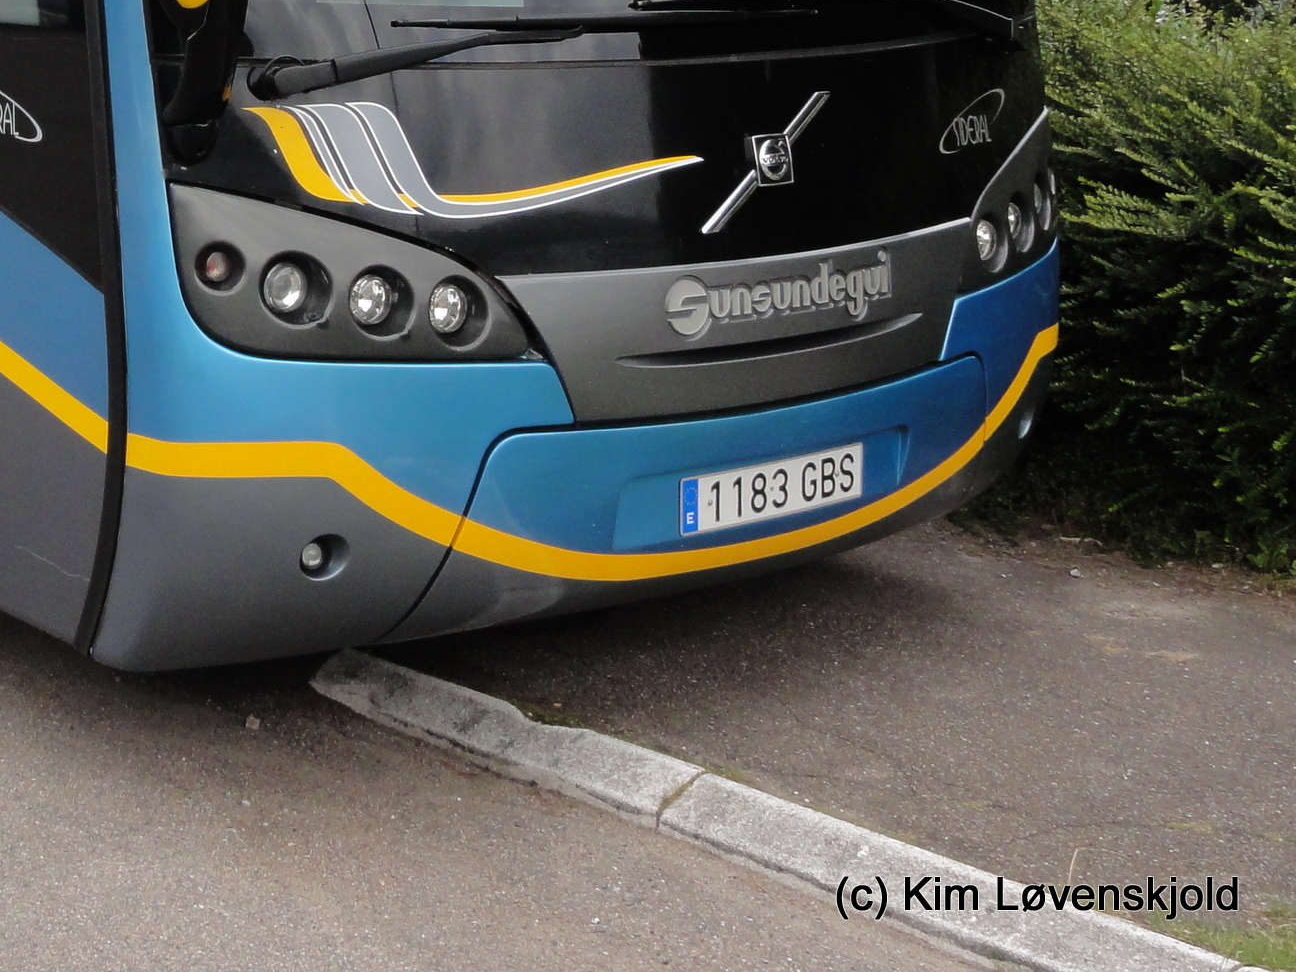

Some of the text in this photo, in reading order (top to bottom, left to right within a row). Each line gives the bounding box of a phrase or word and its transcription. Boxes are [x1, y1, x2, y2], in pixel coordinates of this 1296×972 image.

[666, 247, 892, 338] Sunsundegui
[686, 512, 694, 525] E
[710, 453, 855, 522] 1183 GBS
